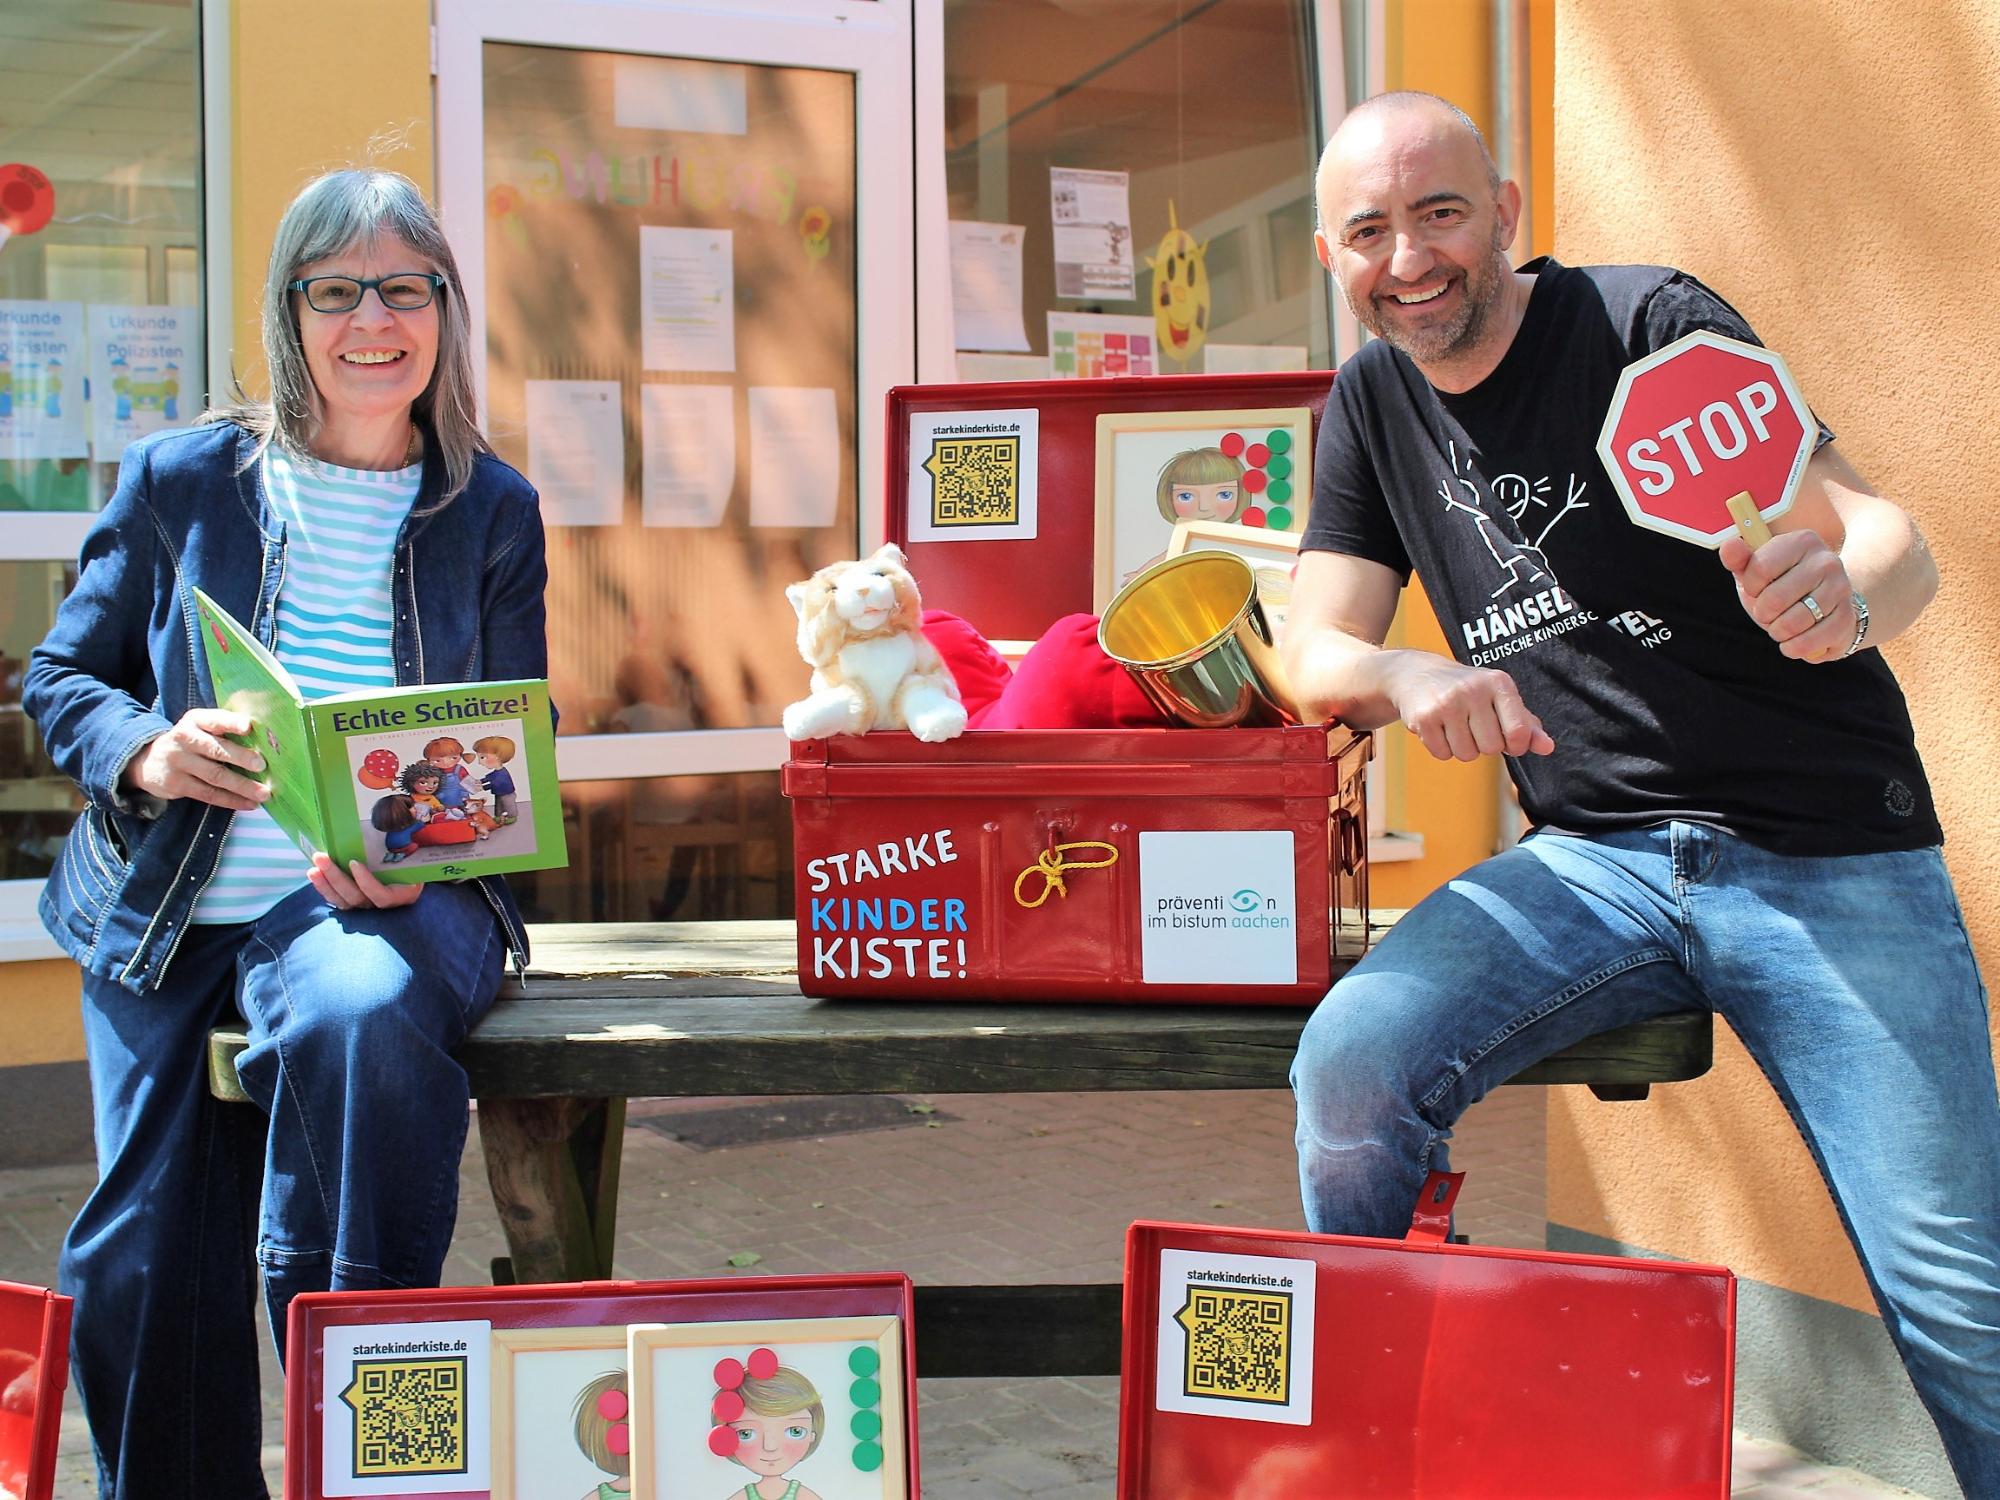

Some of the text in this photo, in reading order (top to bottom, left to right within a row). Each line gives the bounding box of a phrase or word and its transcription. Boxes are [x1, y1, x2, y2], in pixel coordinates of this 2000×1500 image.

[109, 316, 177, 330] Urkunde
[107, 344, 183, 358] Polizisten
[932, 422, 1021, 435] starkekinderkiste.de
[1627, 381, 1777, 496] STOP
[1462, 586, 1573, 650] HÄNSEL
[1472, 635, 1535, 668] DEUTSCHE
[333, 693, 529, 732] Echte Schätze!
[806, 829, 958, 892] STARKE
[811, 897, 968, 933] KINDER
[1148, 912, 1290, 928] im bistum aachen
[813, 936, 967, 979] KISTE!
[1186, 1268, 1293, 1288] starkekinderkiste.de
[352, 1339, 468, 1355] starkekinderkiste.de
